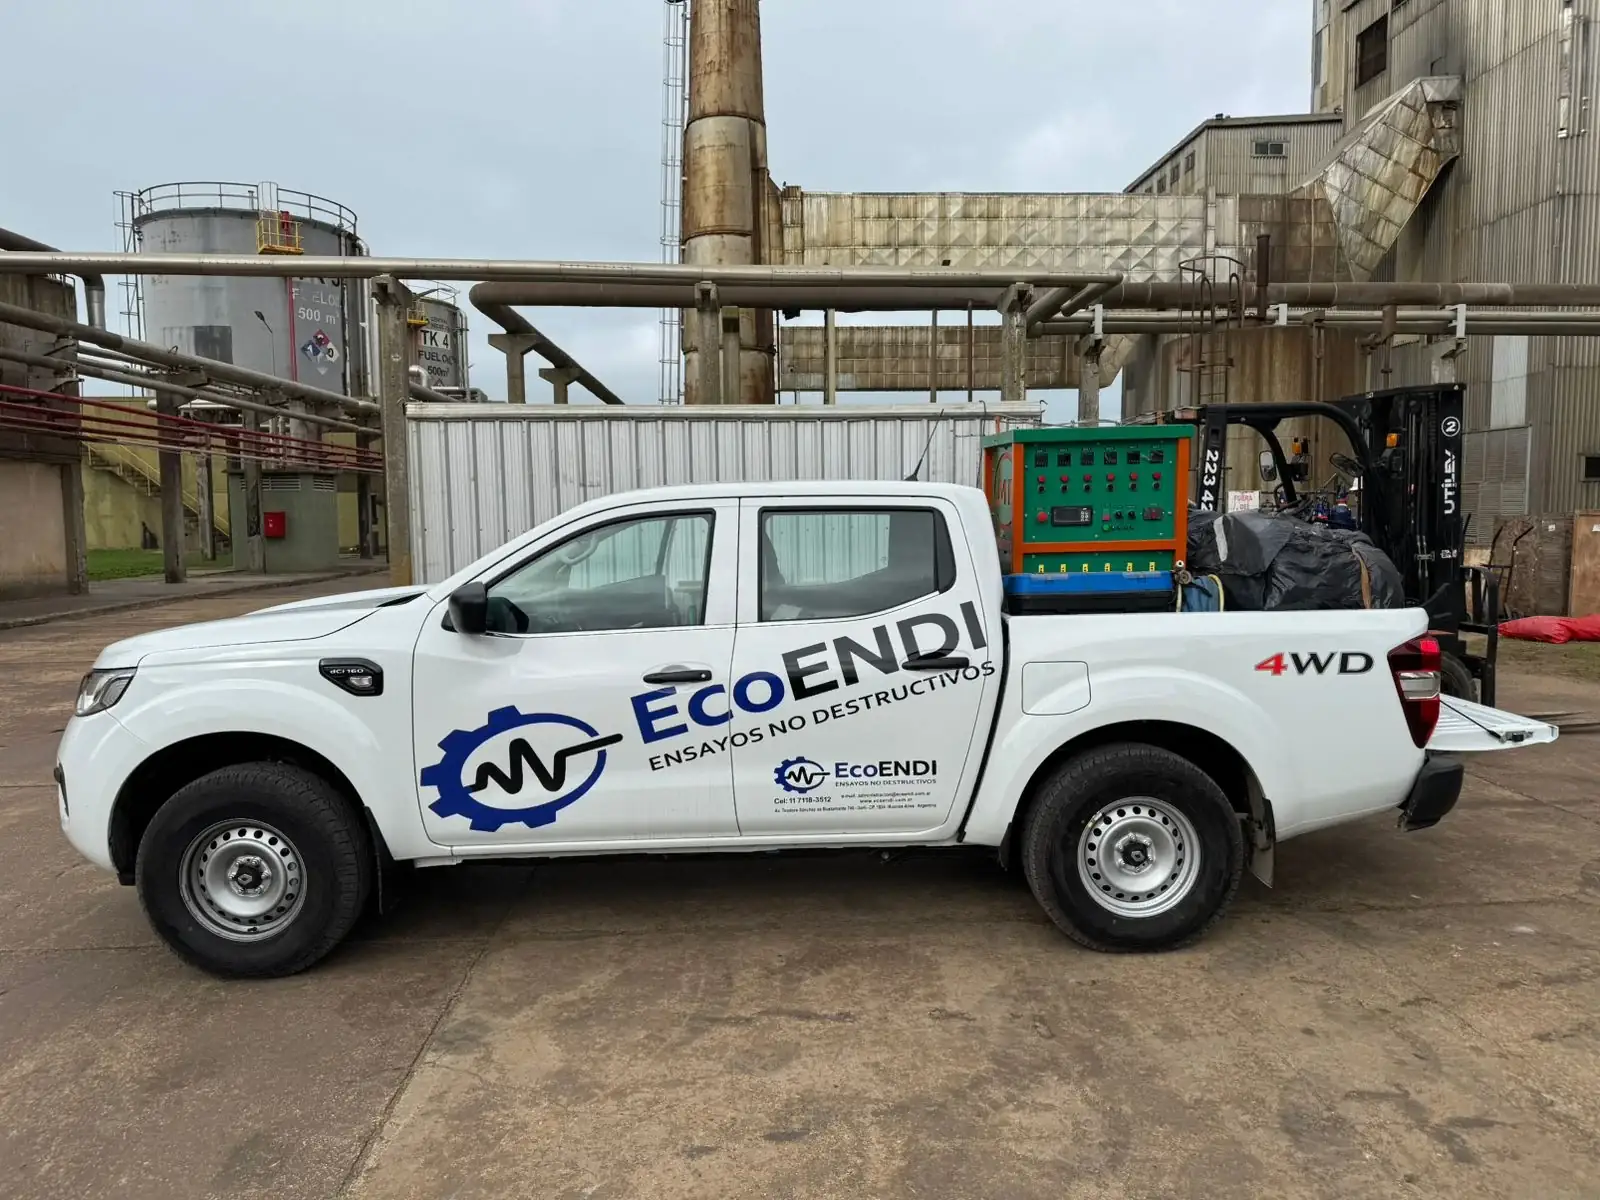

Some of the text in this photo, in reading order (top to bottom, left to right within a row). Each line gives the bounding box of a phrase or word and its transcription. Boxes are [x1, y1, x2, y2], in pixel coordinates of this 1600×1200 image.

[298, 307, 320, 321] 500
[420, 330, 449, 349] TK 4
[1445, 421, 1456, 432] 2
[1203, 449, 1219, 486] 223
[1254, 652, 1375, 676] 4WD
[649, 660, 995, 771] ENSAYOS NO DESTRUCTIVOS
[835, 760, 937, 778] EcoENDI
